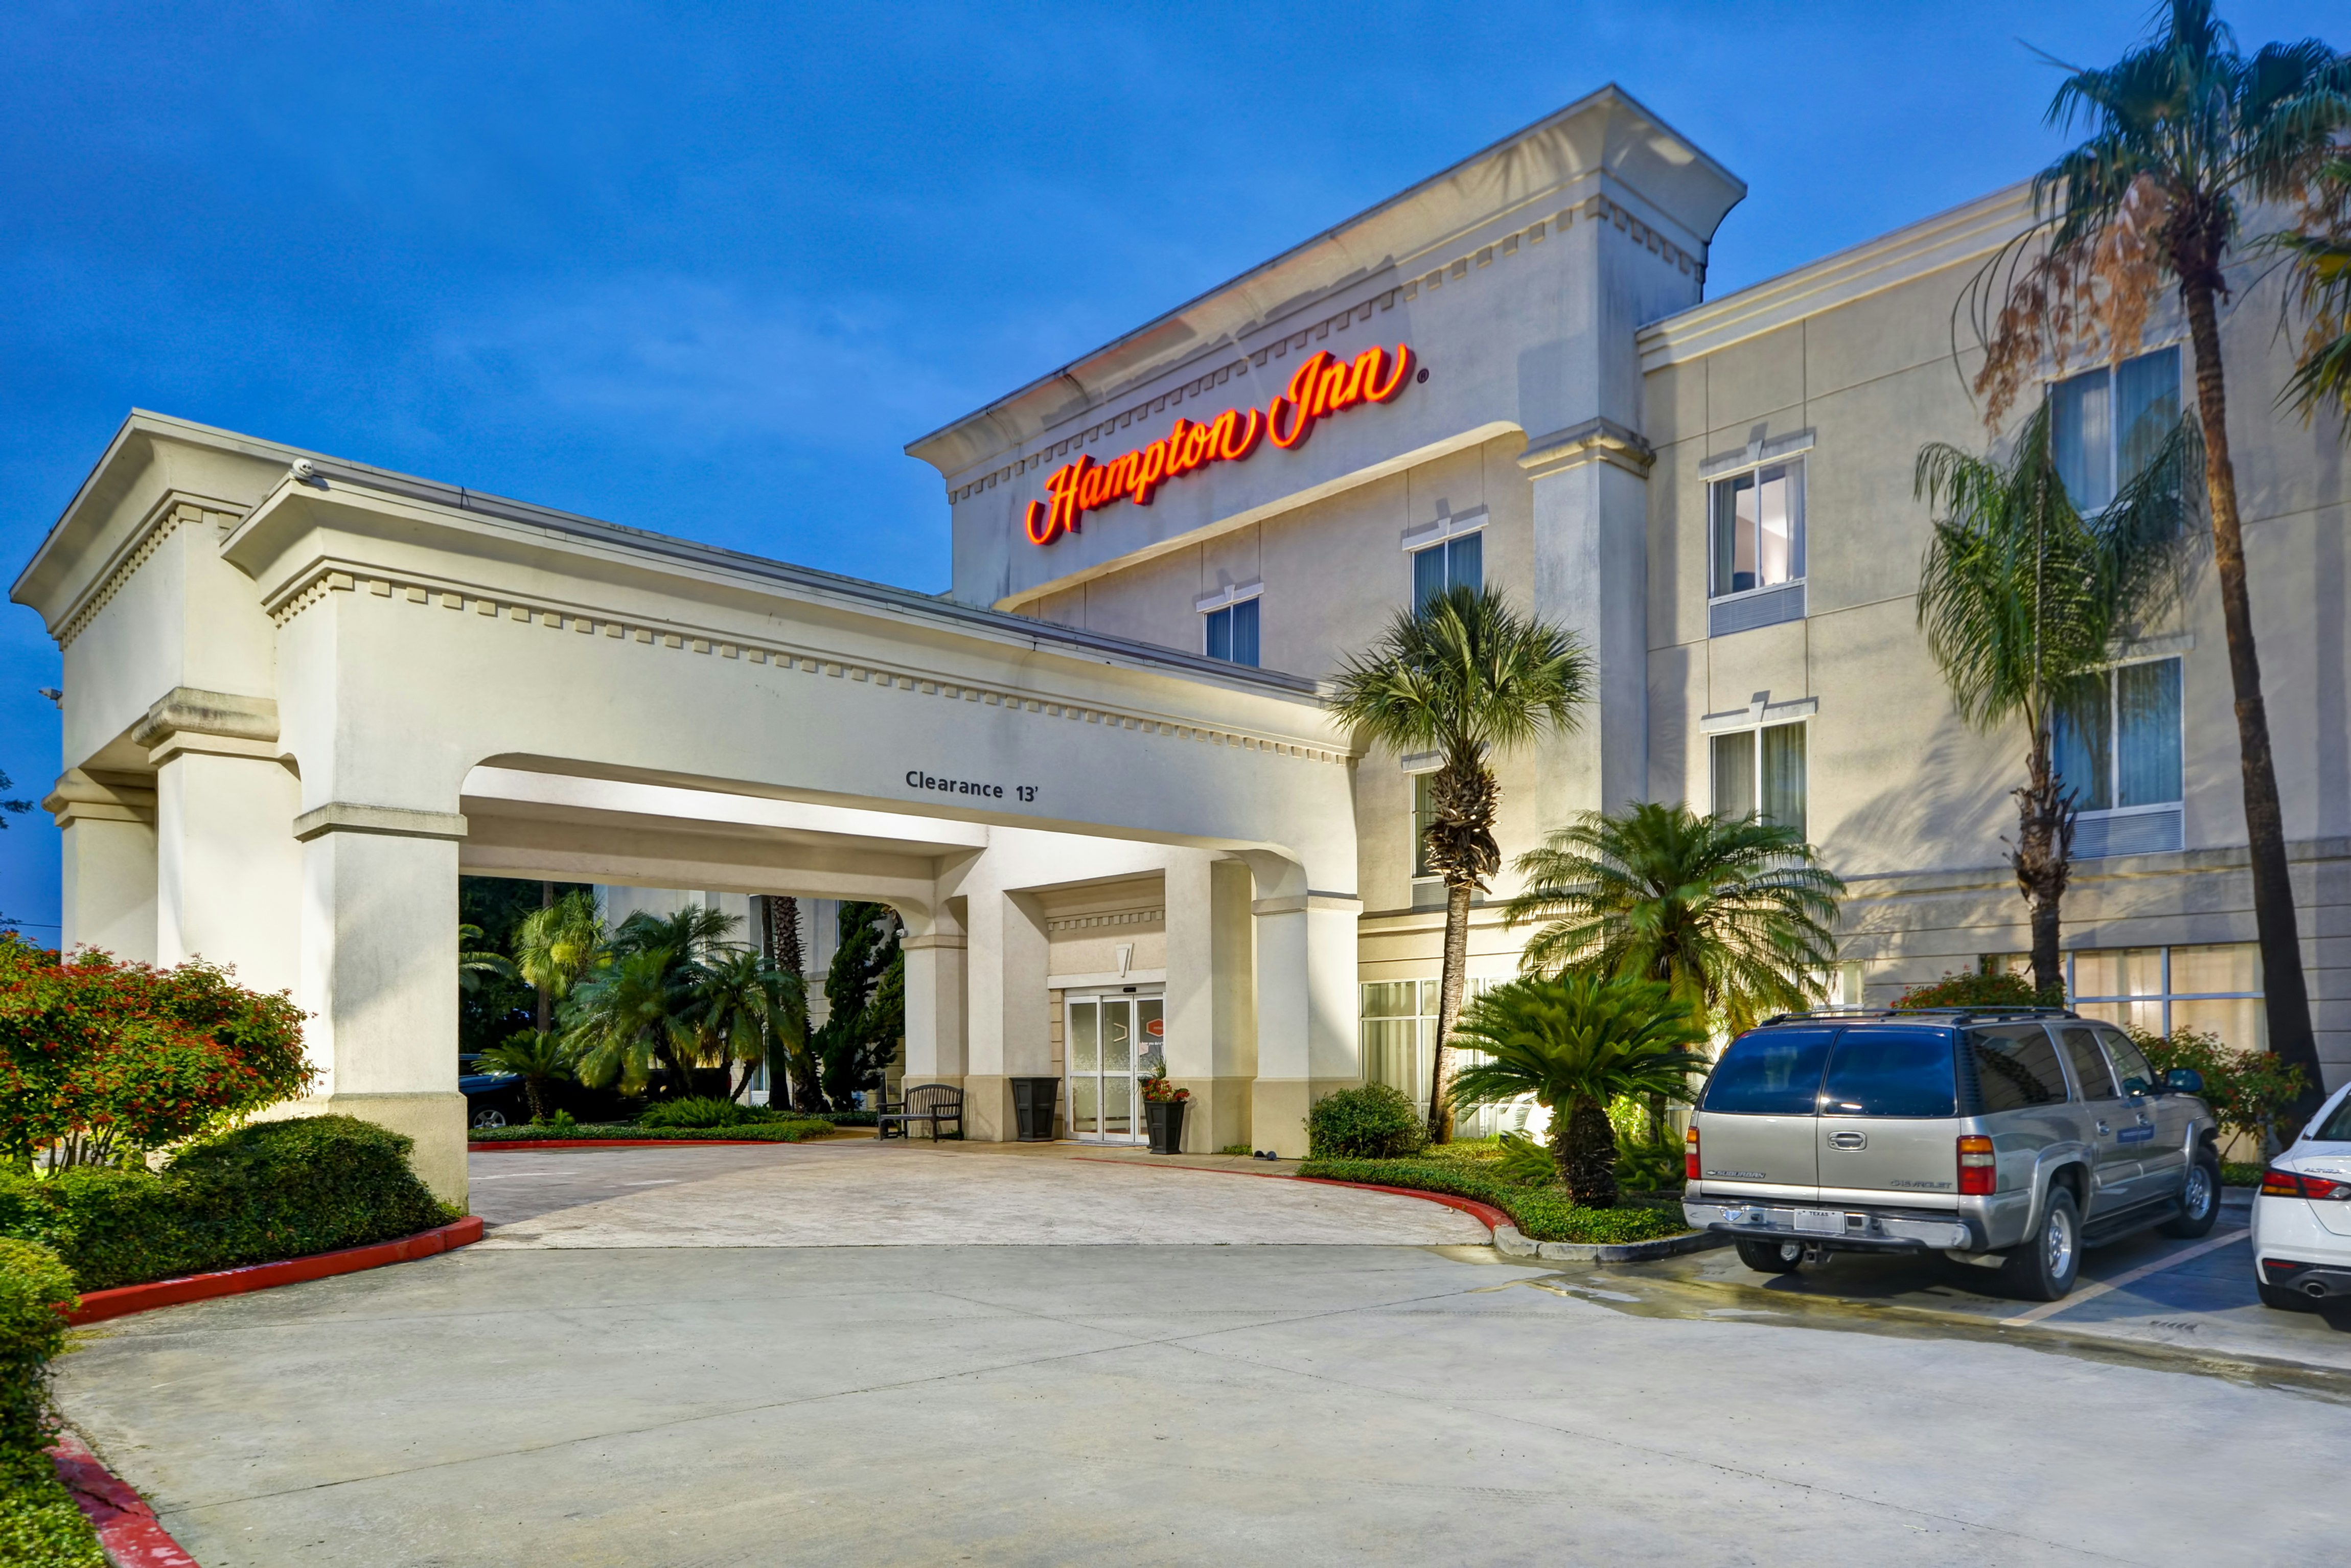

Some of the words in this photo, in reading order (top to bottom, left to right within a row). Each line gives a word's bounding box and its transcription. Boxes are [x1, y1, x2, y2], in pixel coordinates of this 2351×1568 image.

[1026, 407, 1266, 545] Hampton
[1266, 343, 1416, 449] Inn
[906, 771, 1003, 799] Clearance
[1016, 785, 1039, 802] 13'
[1716, 1170, 1766, 1179] SUBURBAN
[1891, 1180, 1952, 1189] CHEVROLET
